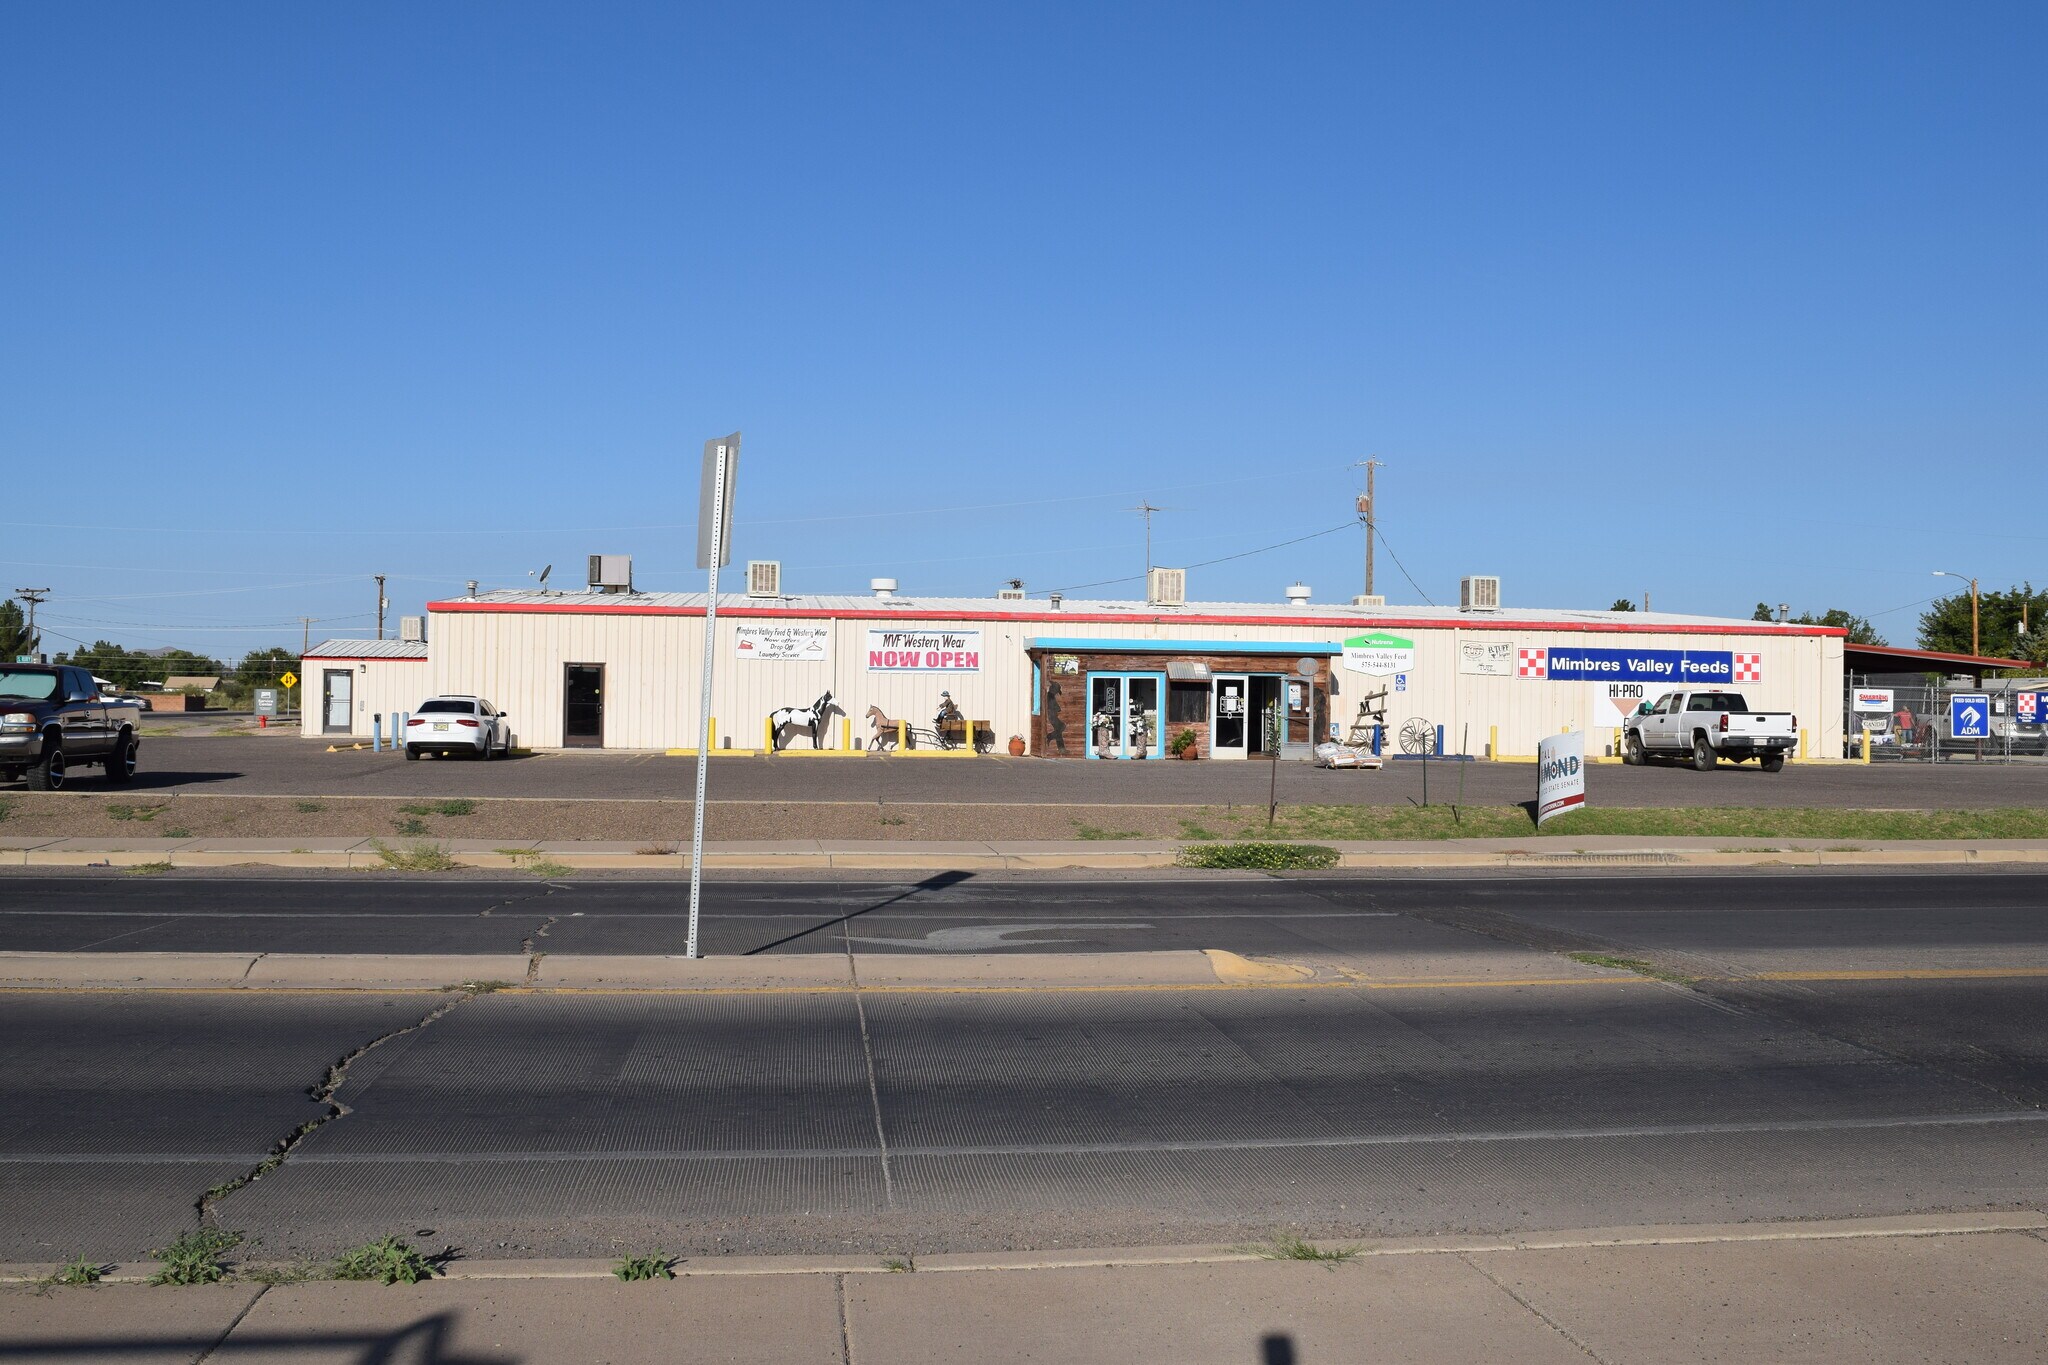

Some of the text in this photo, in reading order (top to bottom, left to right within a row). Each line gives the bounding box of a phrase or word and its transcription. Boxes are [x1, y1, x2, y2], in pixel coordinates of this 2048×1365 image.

[736, 627, 828, 638] Mimbres Valley Feed & Western Wear
[770, 643, 794, 651] Drop Off
[883, 634, 966, 651] MVF Western Wear
[758, 651, 781, 659] Laundry
[869, 651, 979, 668] NOW OPEN
[1551, 657, 1730, 675] Mimbres Valley Feeds
[1608, 683, 1643, 698] HI-PRO
[1960, 727, 1980, 735] ADM
[1548, 783, 1560, 793] STATE
[1560, 778, 1580, 789] SENATE
